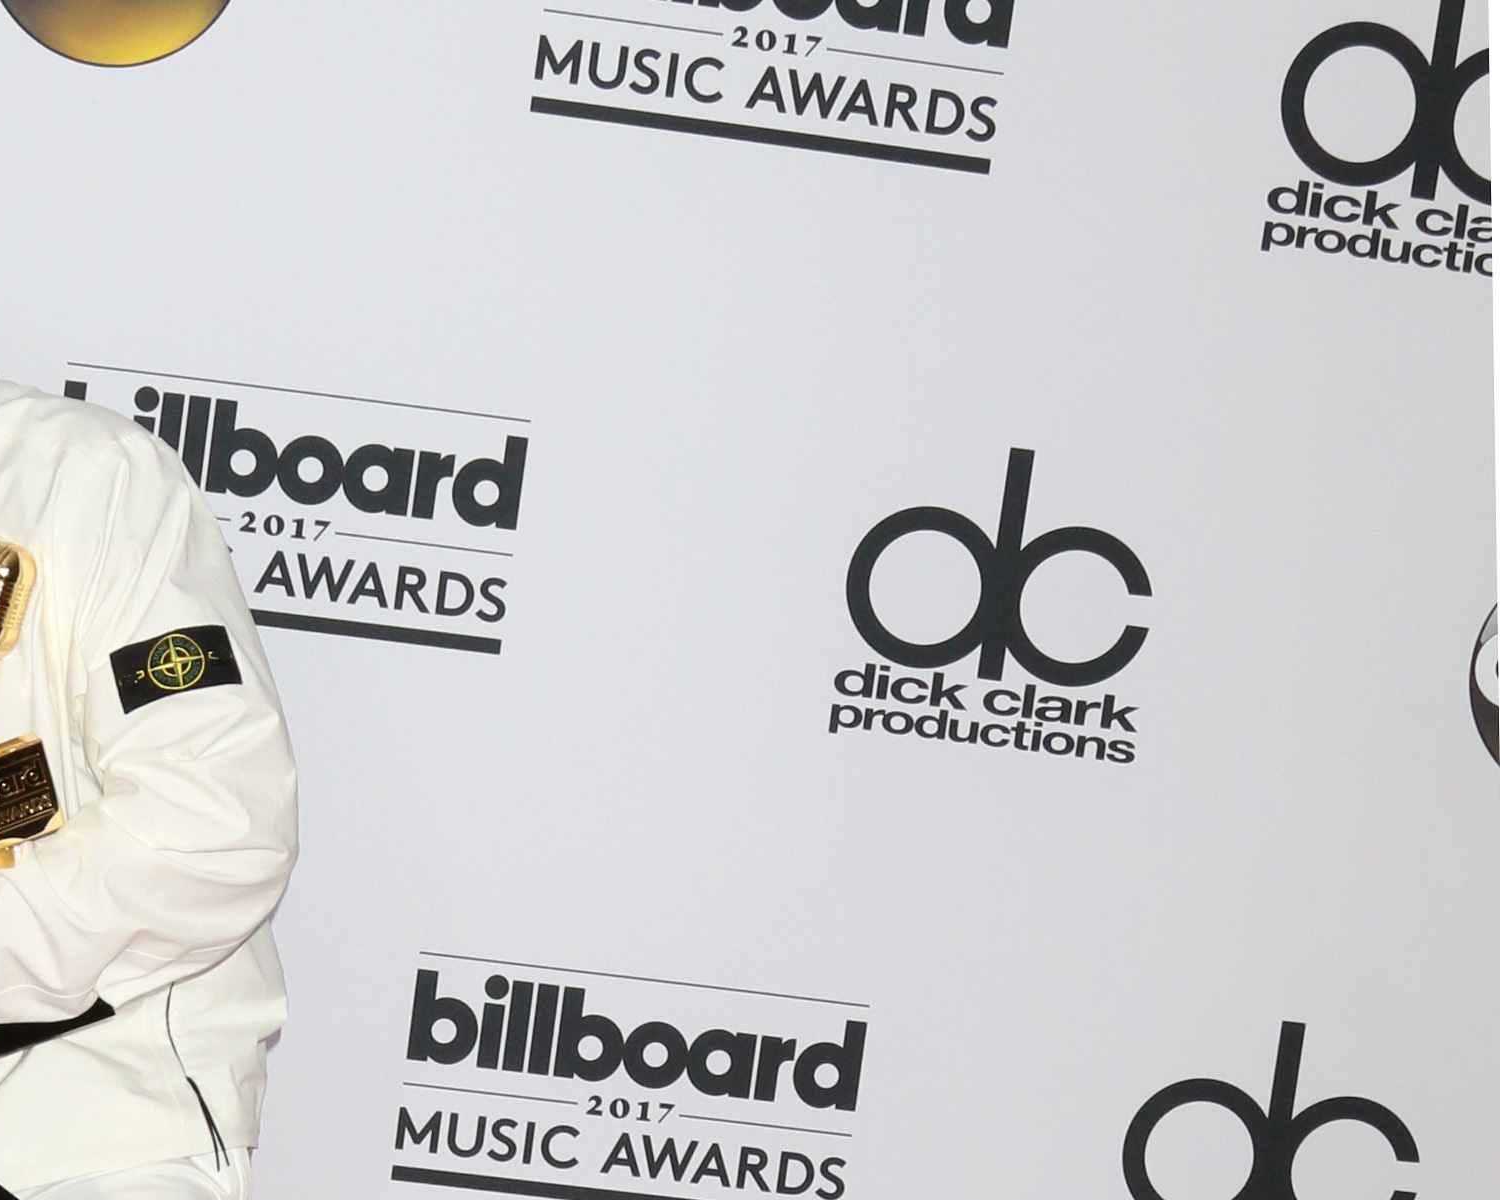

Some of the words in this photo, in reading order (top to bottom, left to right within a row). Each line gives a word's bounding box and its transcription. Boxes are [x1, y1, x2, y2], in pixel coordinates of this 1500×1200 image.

[732, 26, 822, 56] 2017
[535, 35, 724, 103] MUSIC
[745, 66, 997, 142] AWARDS
[1267, 180, 1400, 230] dick
[1416, 204, 1493, 241] cla
[1261, 221, 1493, 277] productio
[64, 380, 528, 530] llboard
[240, 512, 330, 540] 2017
[254, 551, 507, 622] AWARDS
[834, 663, 967, 710] dick
[983, 684, 1138, 732] clark
[829, 704, 1135, 763] productions
[407, 969, 867, 1111] billboard
[587, 1096, 675, 1123] 2017
[395, 1107, 579, 1169] MUSIC
[600, 1133, 846, 1200] AWARDS
